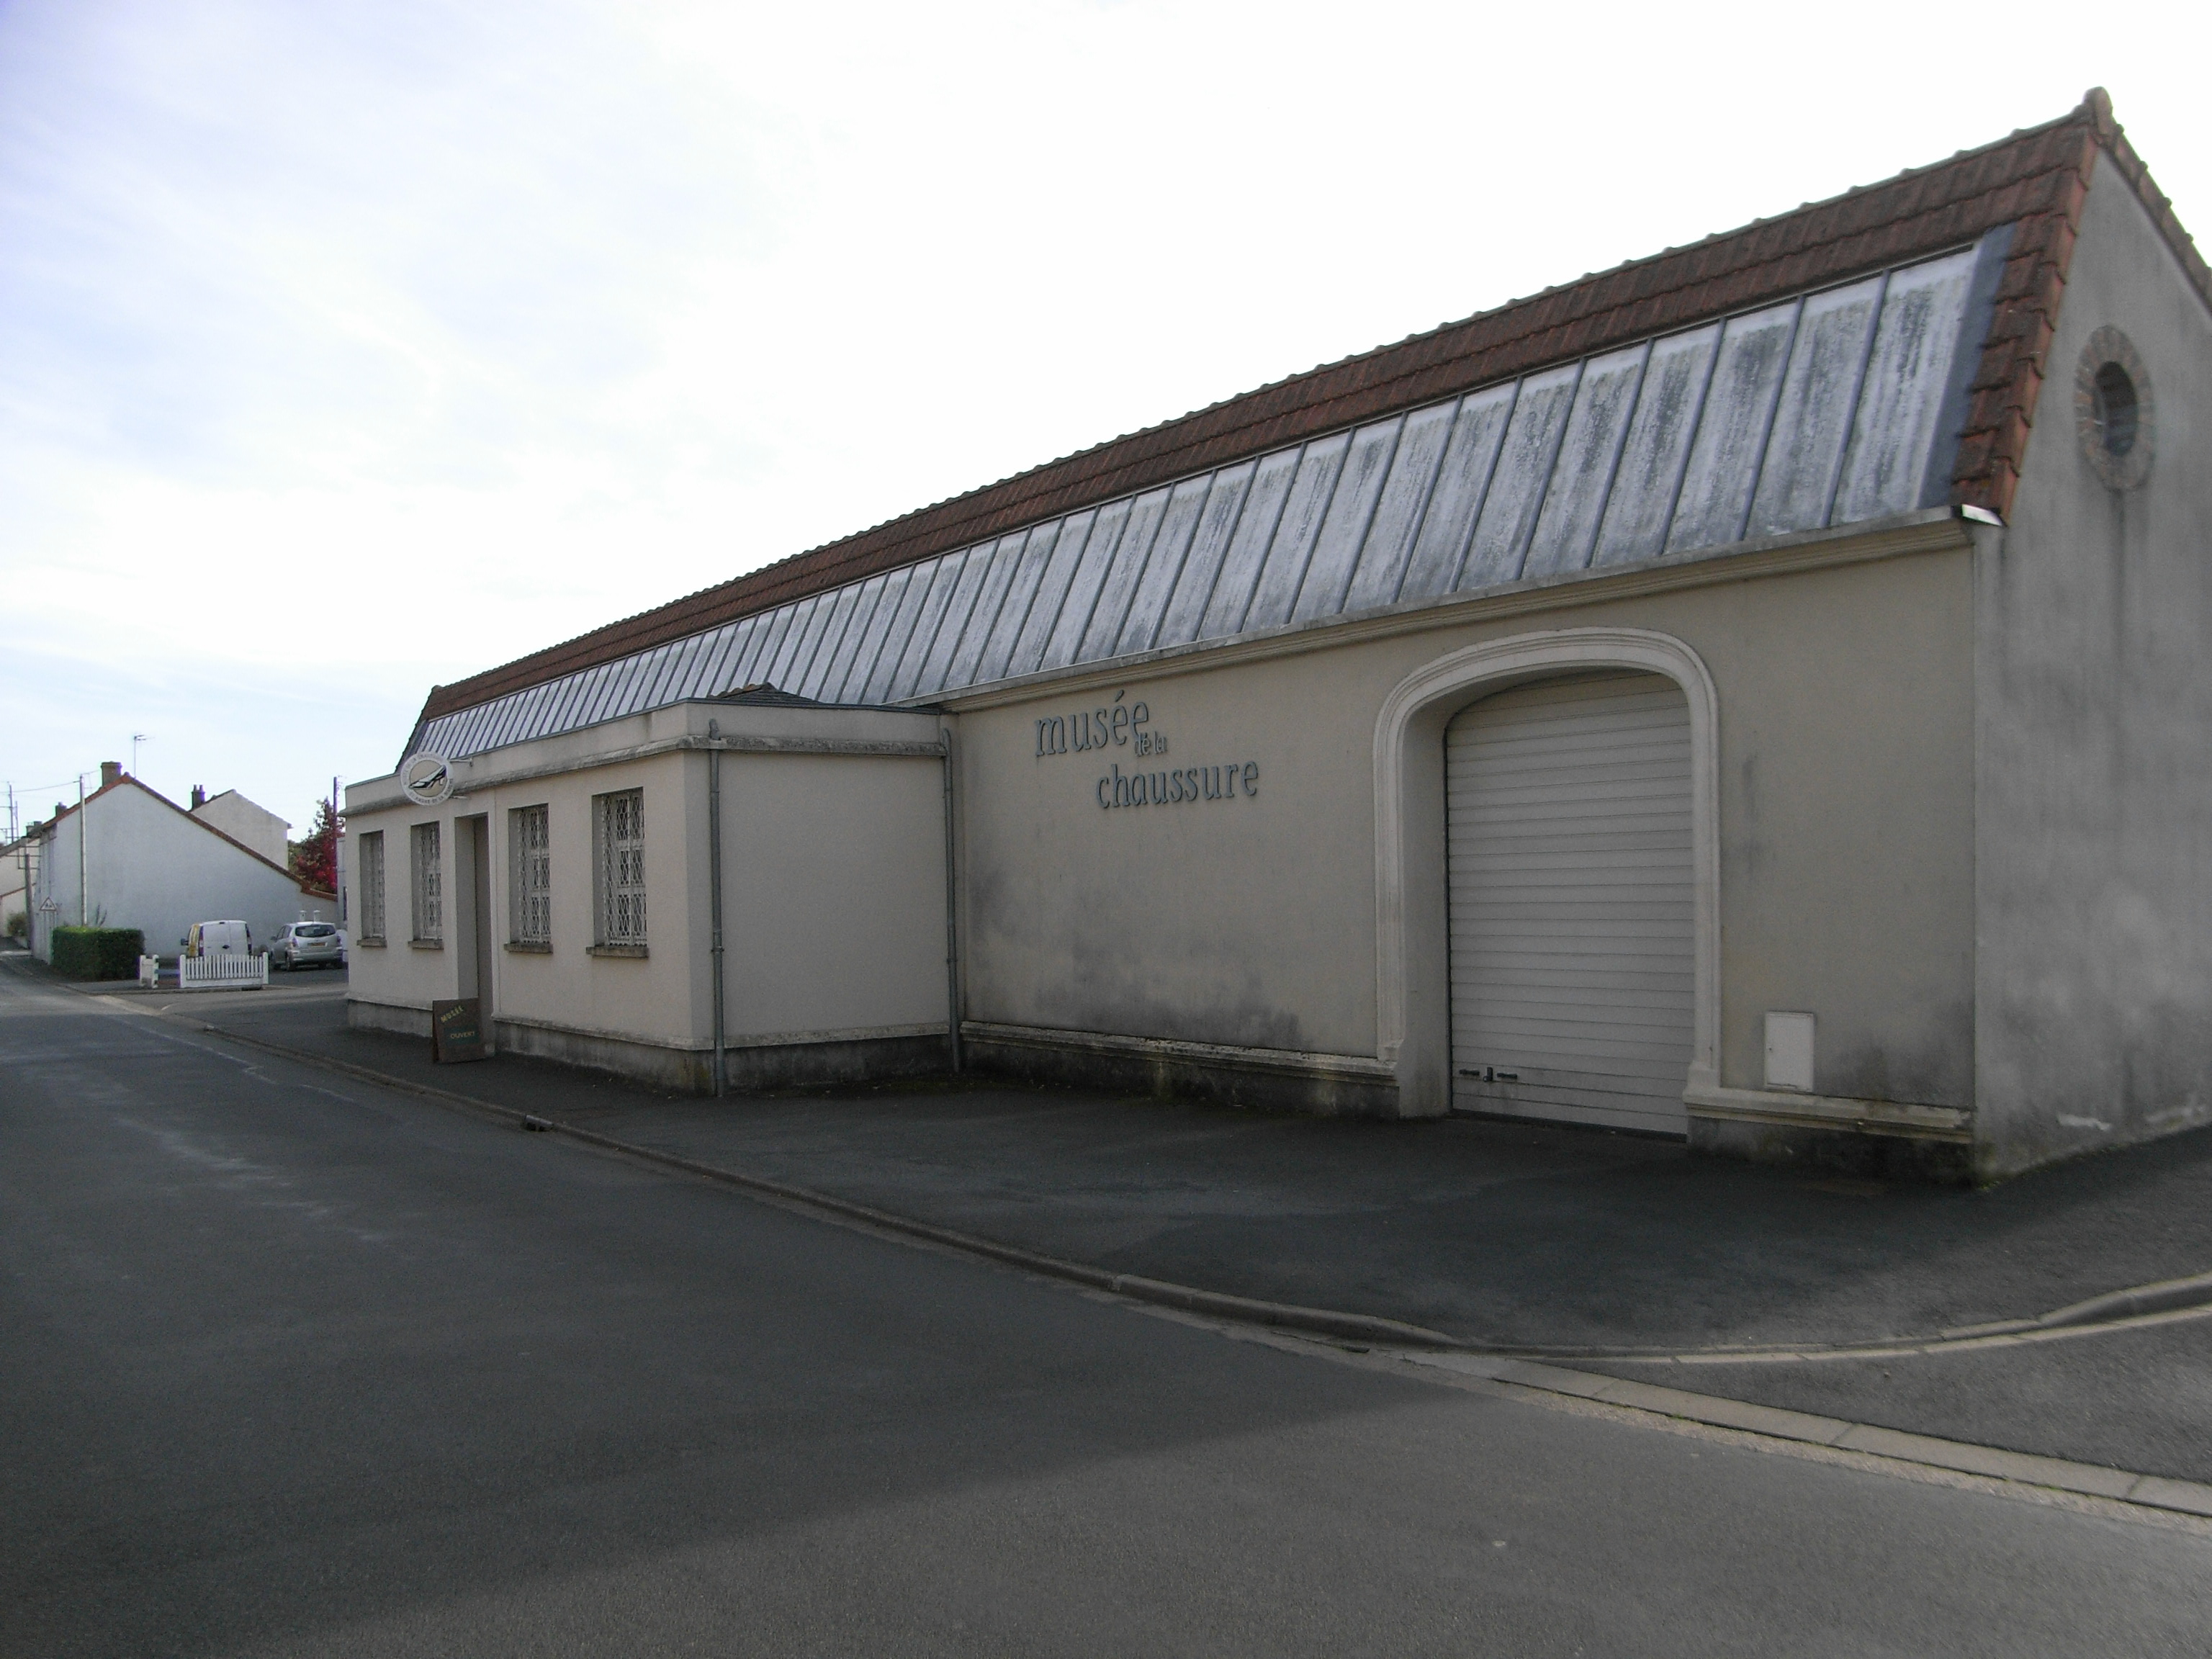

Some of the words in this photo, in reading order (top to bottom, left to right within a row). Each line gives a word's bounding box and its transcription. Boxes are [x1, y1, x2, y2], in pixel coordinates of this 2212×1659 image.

[1033, 688, 1149, 756] musée
[1134, 732, 1150, 757] de
[1153, 731, 1168, 754] la
[1096, 760, 1259, 809] chaussure
